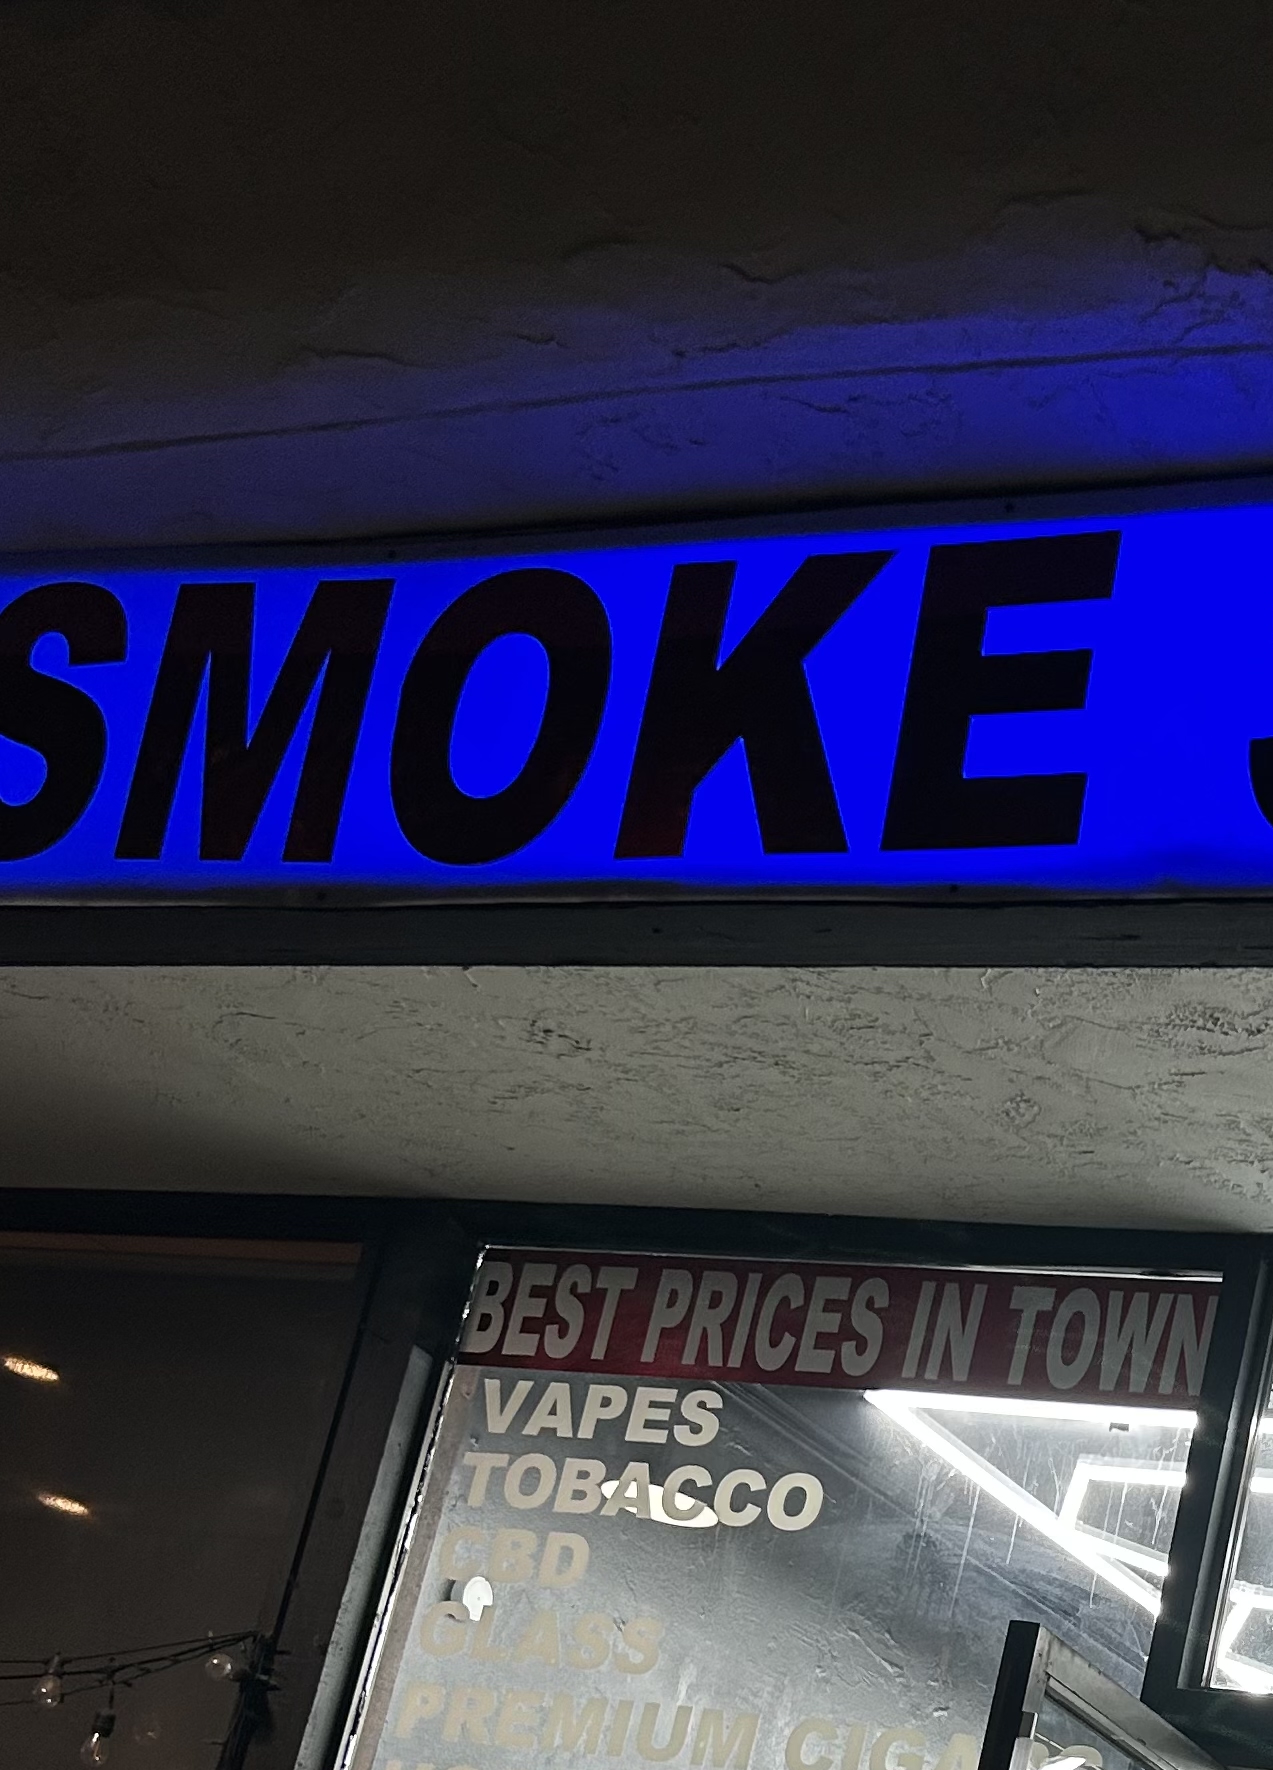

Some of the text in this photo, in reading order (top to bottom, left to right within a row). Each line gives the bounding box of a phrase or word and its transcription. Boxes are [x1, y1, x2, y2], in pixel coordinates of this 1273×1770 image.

[0, 529, 1122, 866] SMOKE
[460, 1260, 1220, 1397] BEST PRICES IN TOWN
[483, 1377, 724, 1448] VAPES
[463, 1451, 824, 1531] TOBACCO
[438, 1526, 590, 1590] CBD
[420, 1600, 664, 1676] GLASS
